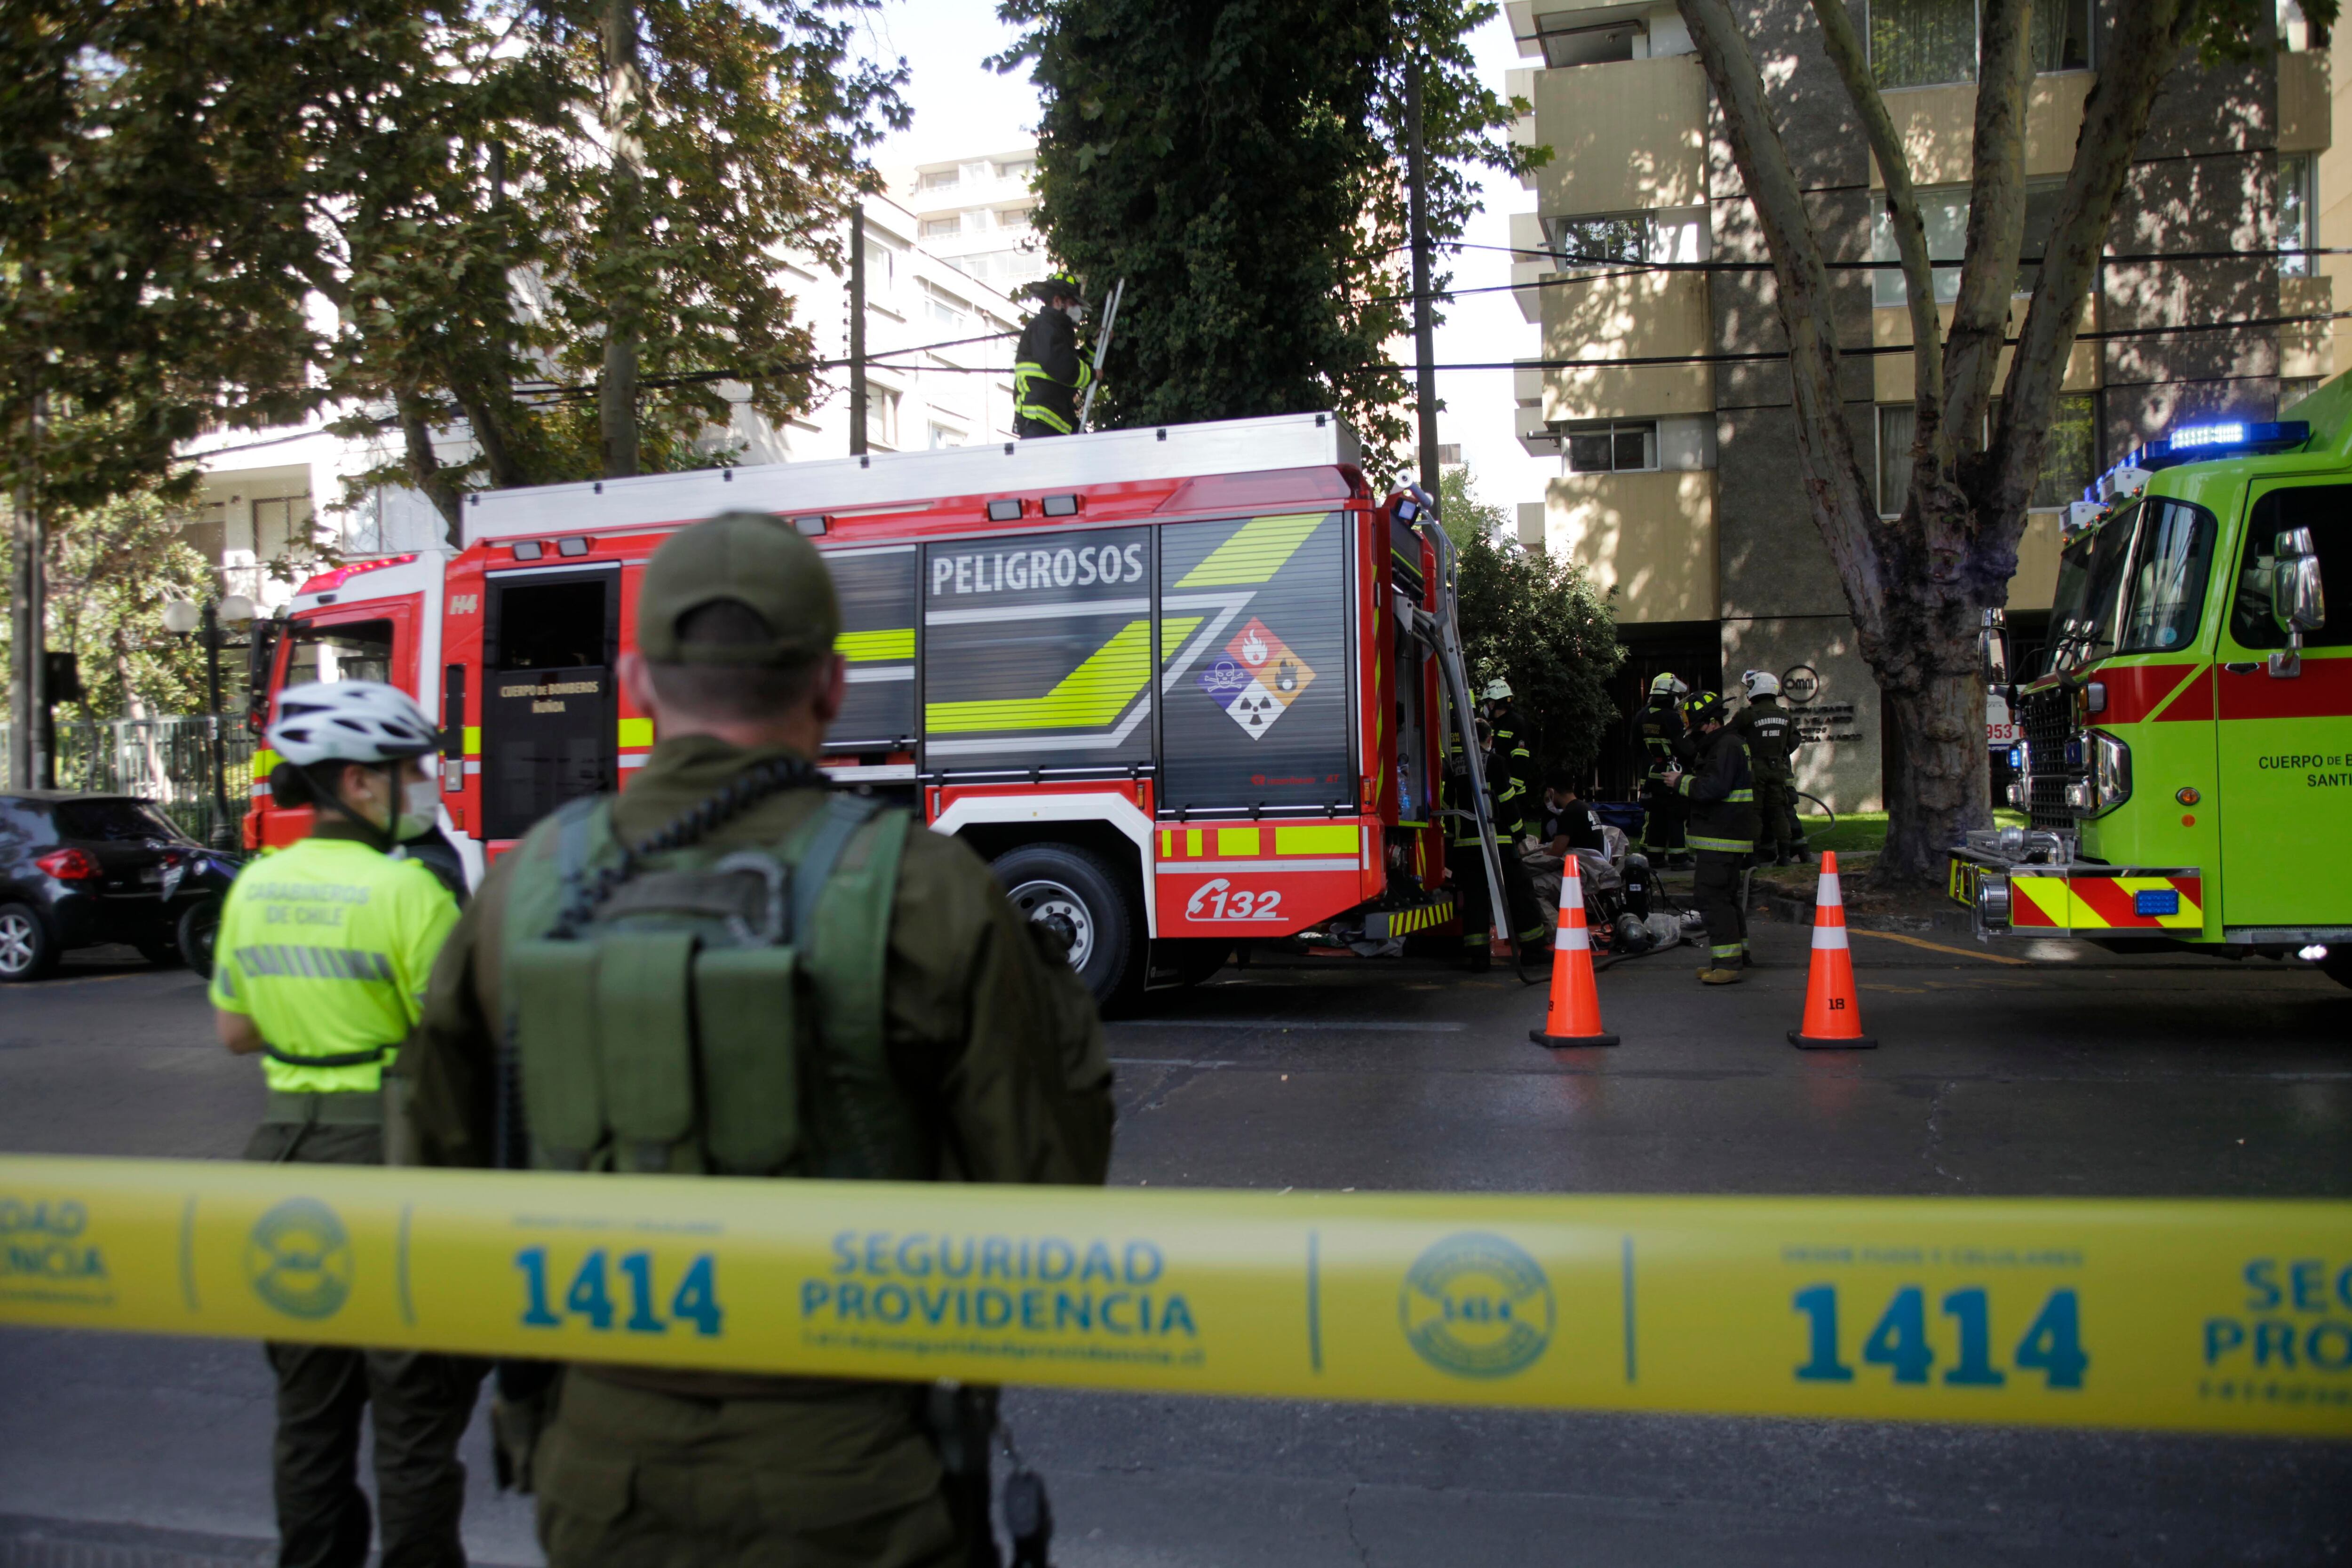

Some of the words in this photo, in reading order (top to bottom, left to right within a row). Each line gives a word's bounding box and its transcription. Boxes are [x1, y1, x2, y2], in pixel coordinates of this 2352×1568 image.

[932, 543, 1144, 595] PELIGROSOS
[450, 594, 478, 615] H4
[1754, 717, 1788, 727] CARABINEROS
[2259, 755, 2323, 769] CUERPO
[2327, 756, 2341, 765] DE
[246, 882, 371, 906] CARABINEROS
[1209, 891, 1282, 919] 132
[266, 905, 290, 924] DE
[295, 906, 343, 926] CHILE
[1828, 998, 1845, 1010] 18
[832, 1229, 1165, 1286] SEGURIDAD
[514, 1243, 724, 1337] 1414
[800, 1278, 1198, 1338] PROVIDENCIA
[1792, 1284, 2090, 1390] 1414
